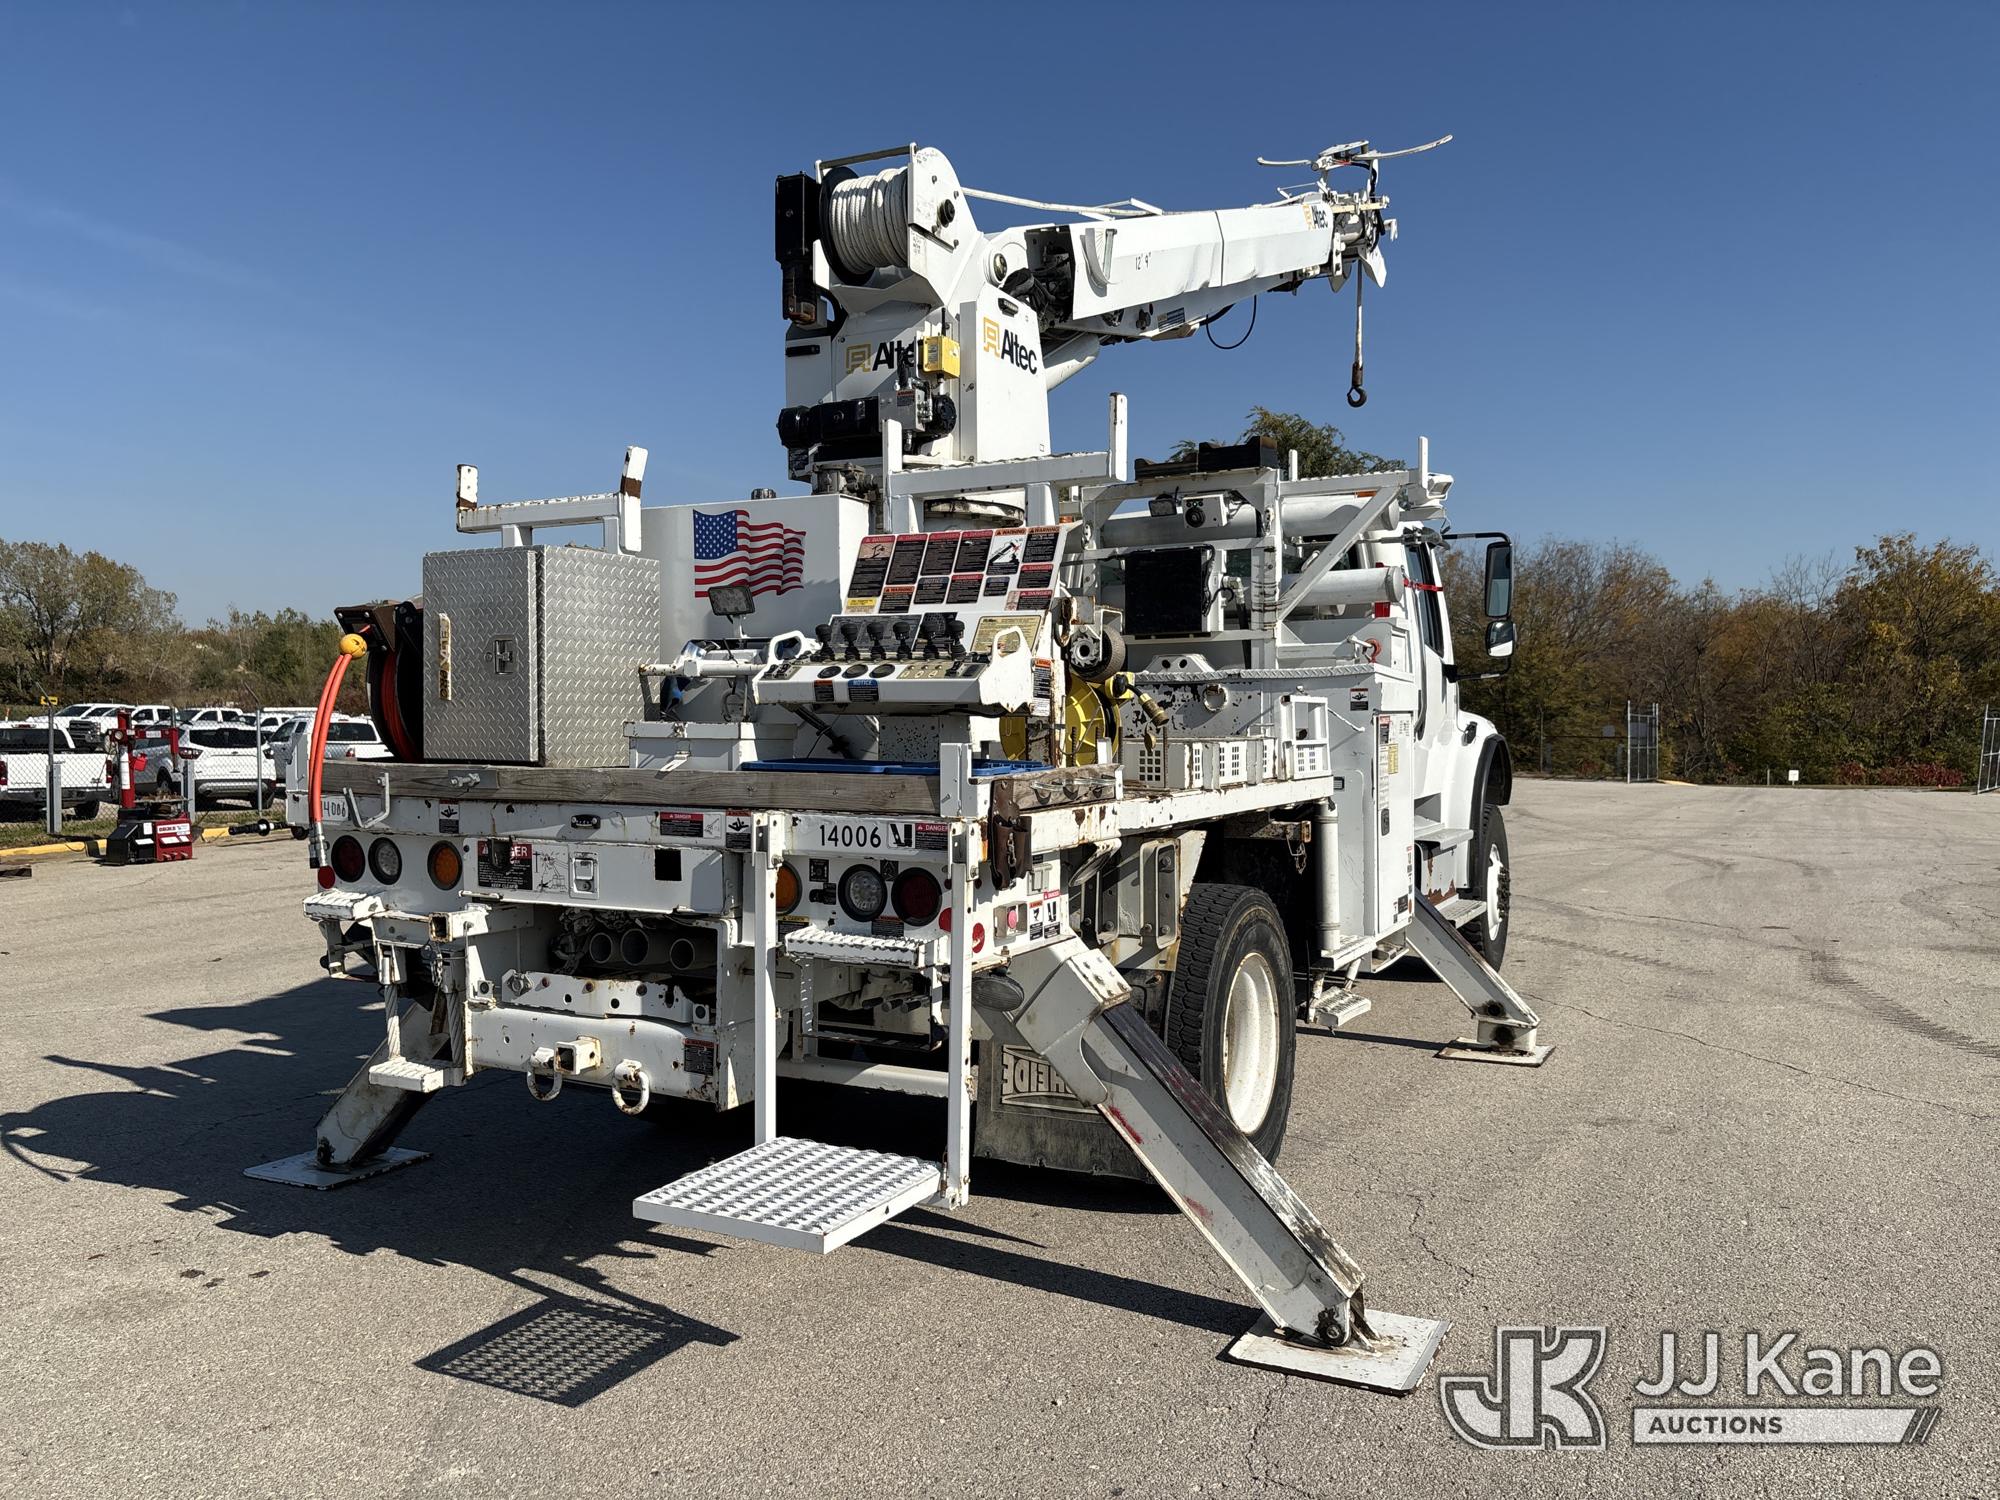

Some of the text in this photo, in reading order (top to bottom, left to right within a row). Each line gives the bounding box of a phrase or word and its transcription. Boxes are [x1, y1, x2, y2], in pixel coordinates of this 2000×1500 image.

[872, 340, 915, 371] Alte
[1001, 329, 1037, 375] Altec
[321, 801, 346, 817] 4006
[820, 824, 881, 848] 14006
